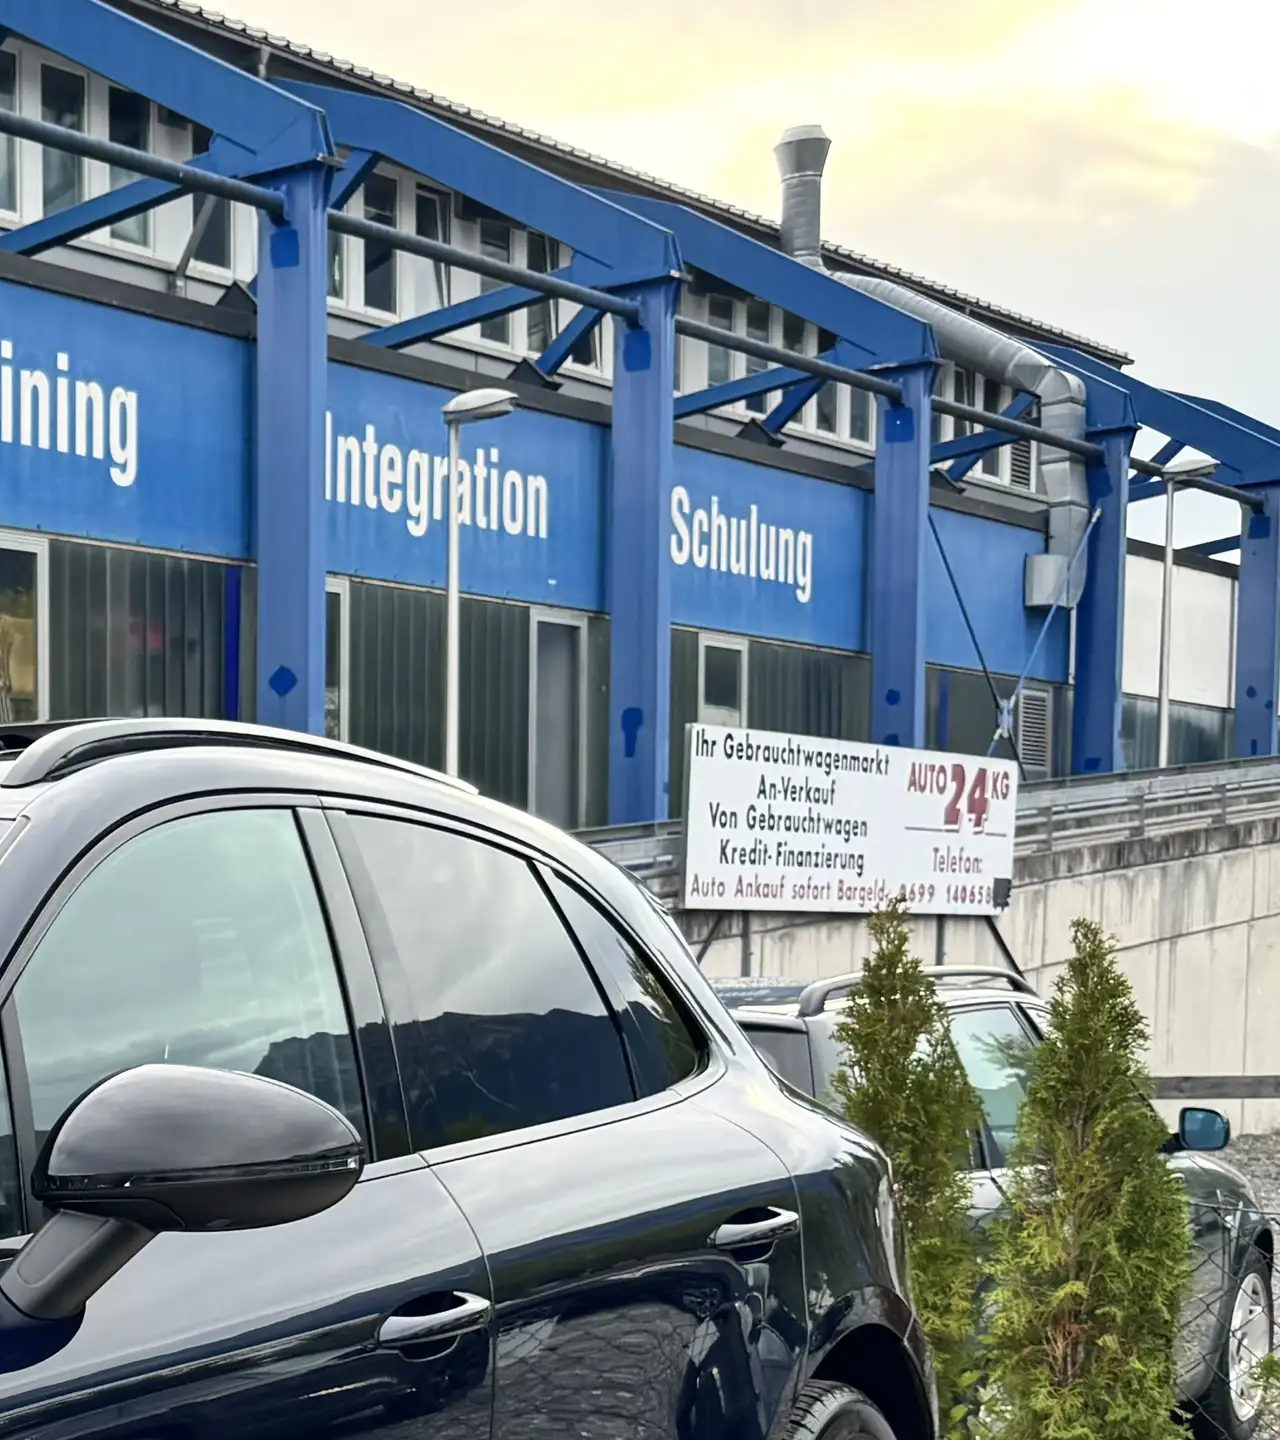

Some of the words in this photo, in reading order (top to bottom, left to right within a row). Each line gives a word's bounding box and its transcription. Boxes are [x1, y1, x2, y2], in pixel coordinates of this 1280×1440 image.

[324, 410, 548, 539] Integration
[669, 485, 813, 603] Schulung
[695, 728, 717, 758] Ihr
[723, 732, 891, 777] Gebrauchtwagenmarkt
[756, 773, 837, 806] An-Verkauf
[907, 761, 948, 796] AUTO
[943, 763, 990, 832] 24
[990, 770, 1010, 800] KG
[708, 801, 738, 830] Von
[745, 803, 868, 844] Gebrauchtwagen
[690, 873, 726, 898] Auto
[734, 873, 786, 899] Ankauf
[791, 875, 832, 900] sofort
